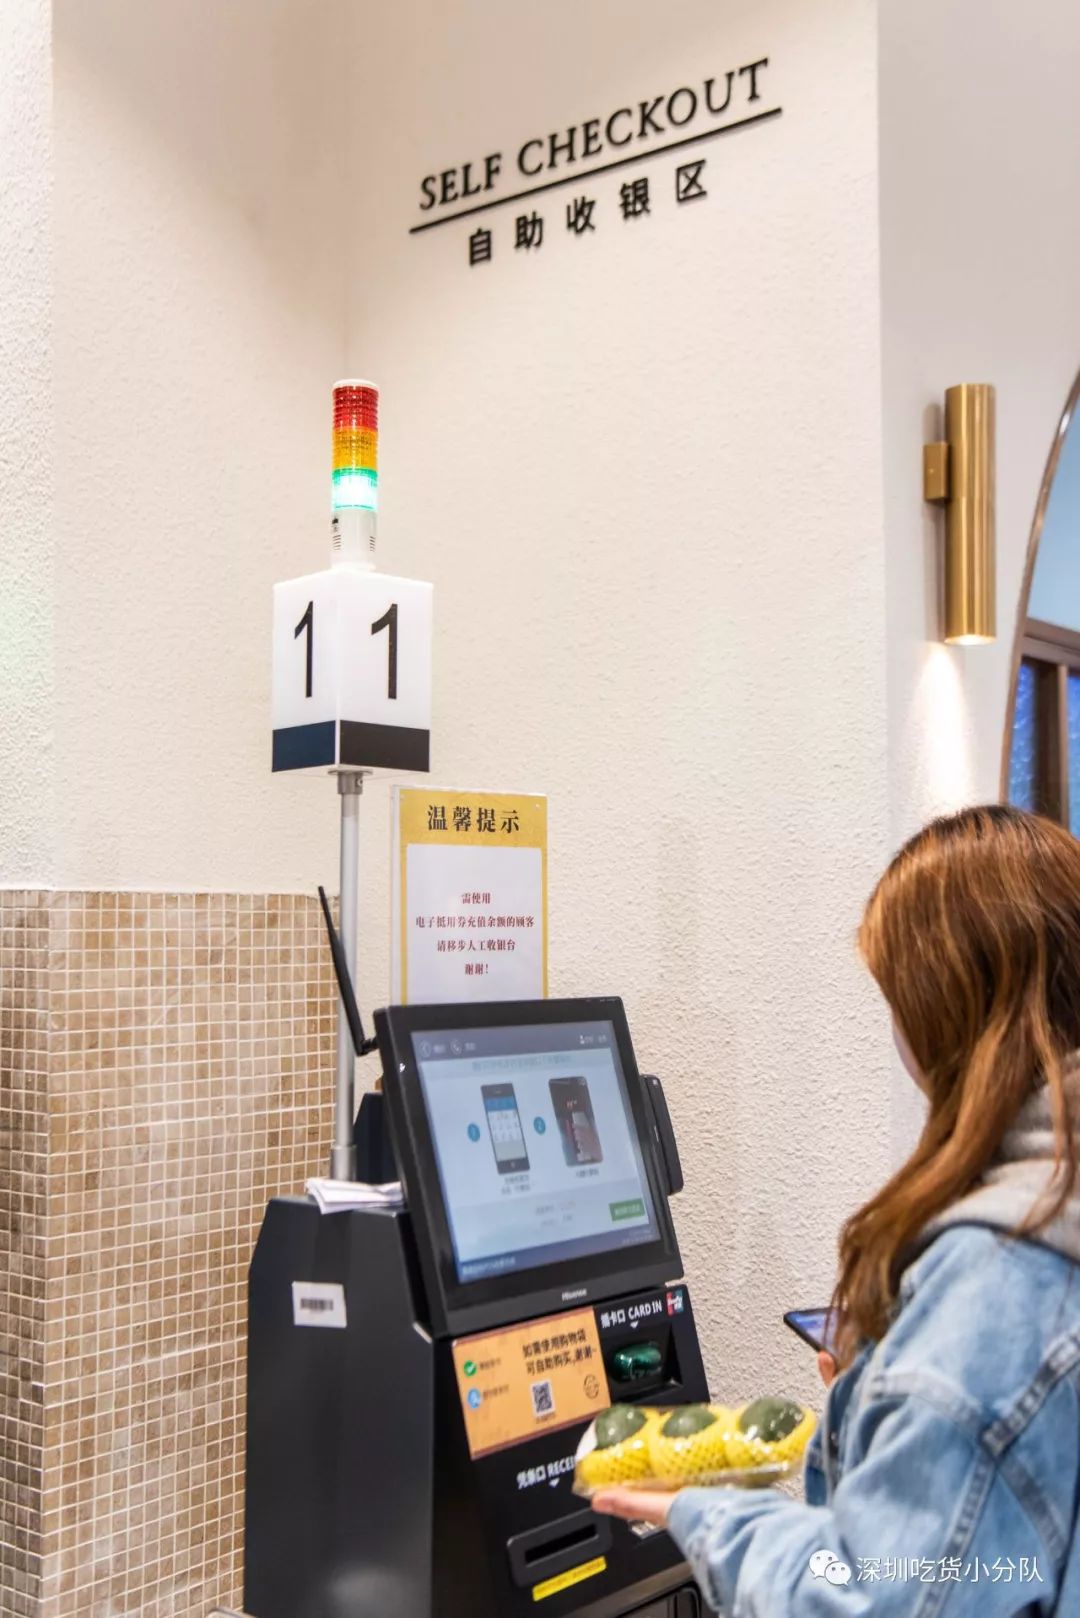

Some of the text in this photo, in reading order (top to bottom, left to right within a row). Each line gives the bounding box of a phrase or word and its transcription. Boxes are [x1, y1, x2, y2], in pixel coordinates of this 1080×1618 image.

[419, 57, 769, 211] SELF CHECKOUT
[467, 158, 708, 267] 自助收银区
[294, 600, 313, 698] 1
[371, 603, 398, 700] 1
[427, 804, 521, 834] 温馨提示
[461, 892, 491, 905] 需使用
[437, 939, 516, 952] 请移步人工收银台
[628, 1302, 651, 1319] CARD
[652, 1300, 663, 1314] IN
